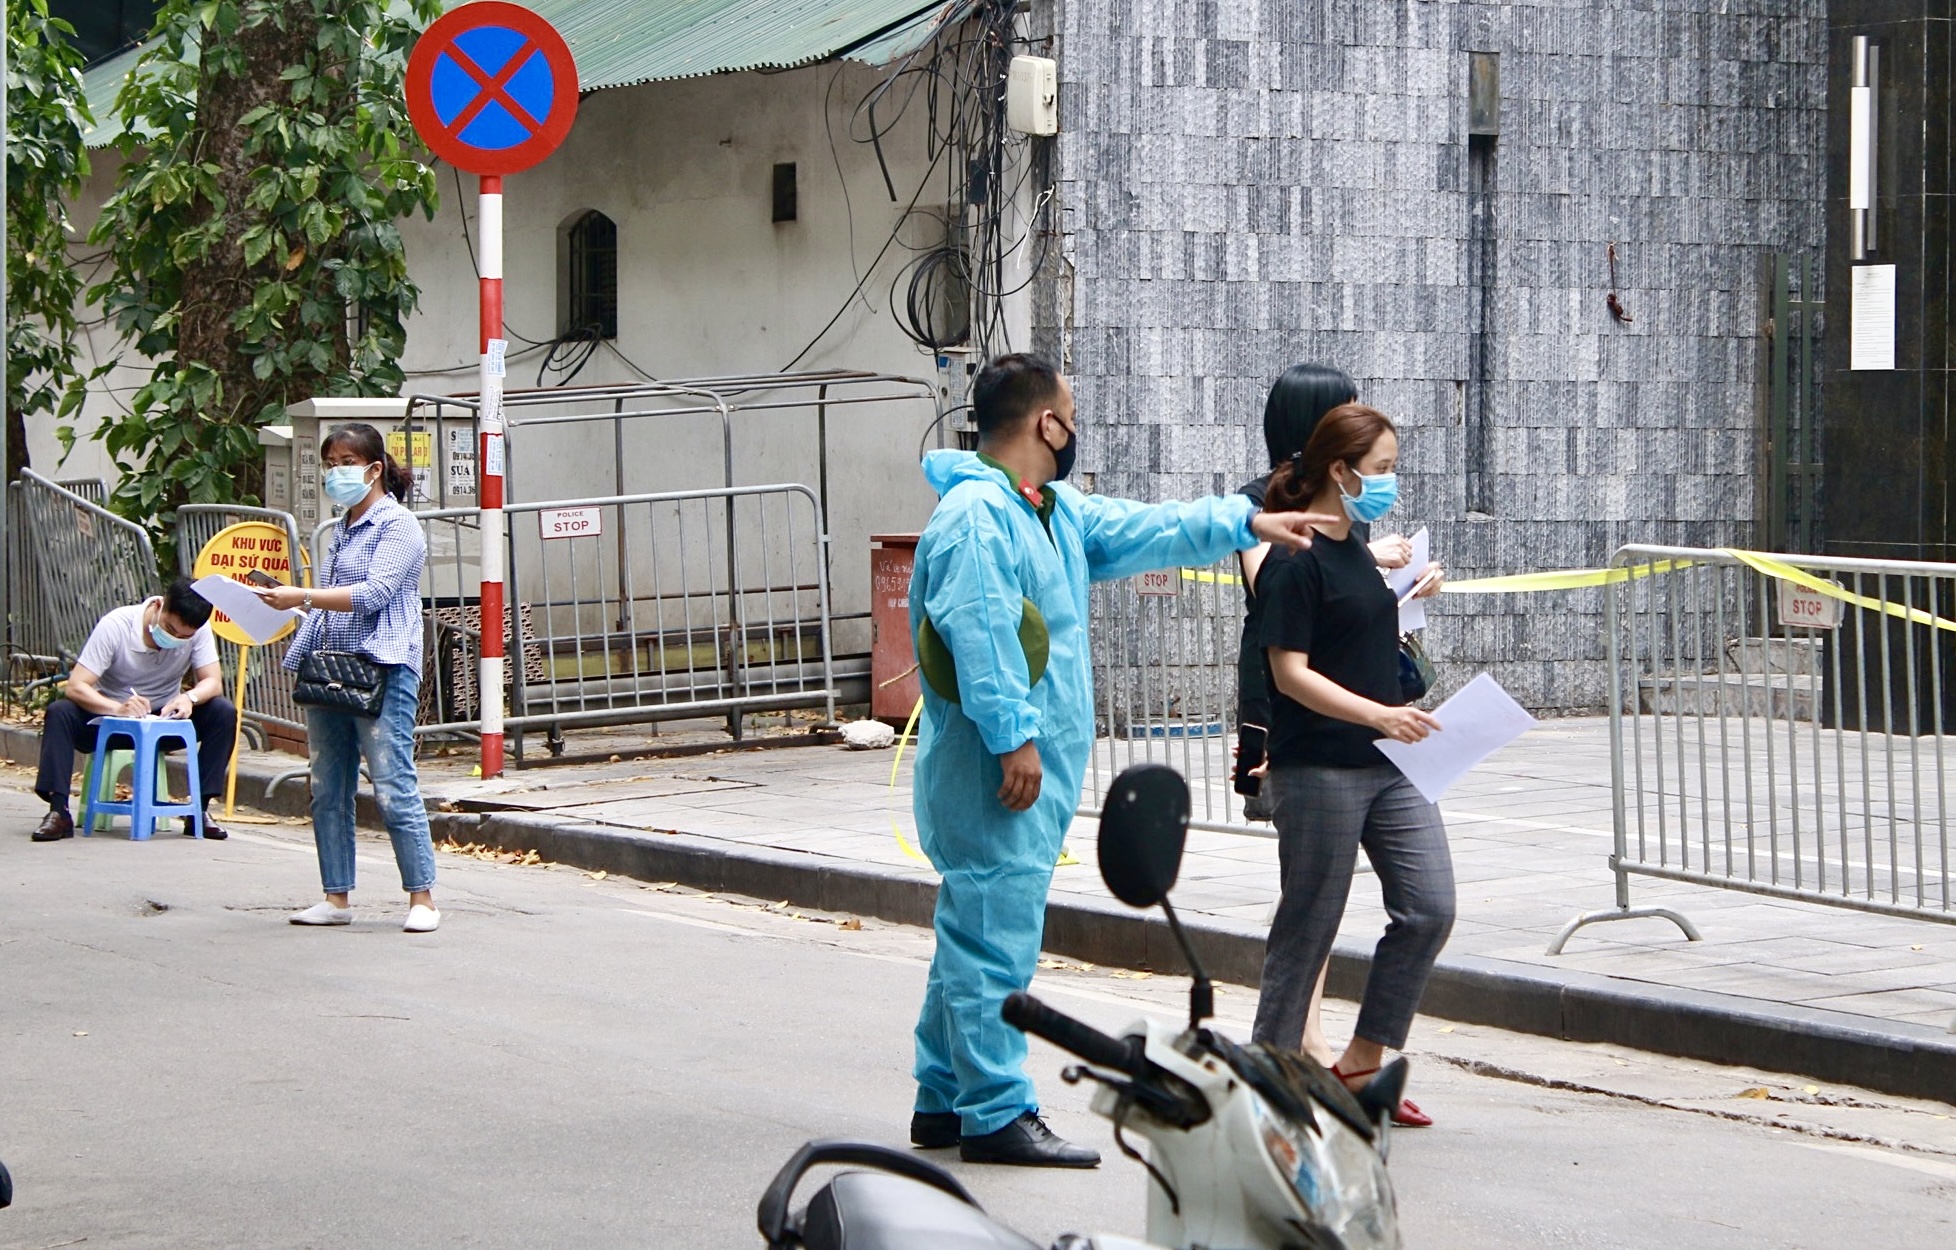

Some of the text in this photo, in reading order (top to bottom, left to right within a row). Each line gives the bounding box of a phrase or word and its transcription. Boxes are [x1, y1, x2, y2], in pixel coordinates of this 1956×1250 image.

[554, 520, 589, 532] STOP
[232, 536, 256, 550] KHU
[211, 553, 290, 571] ĐẠI SỨ QUÁ
[1144, 573, 1168, 587] STOP
[1793, 599, 1822, 615] STOP
